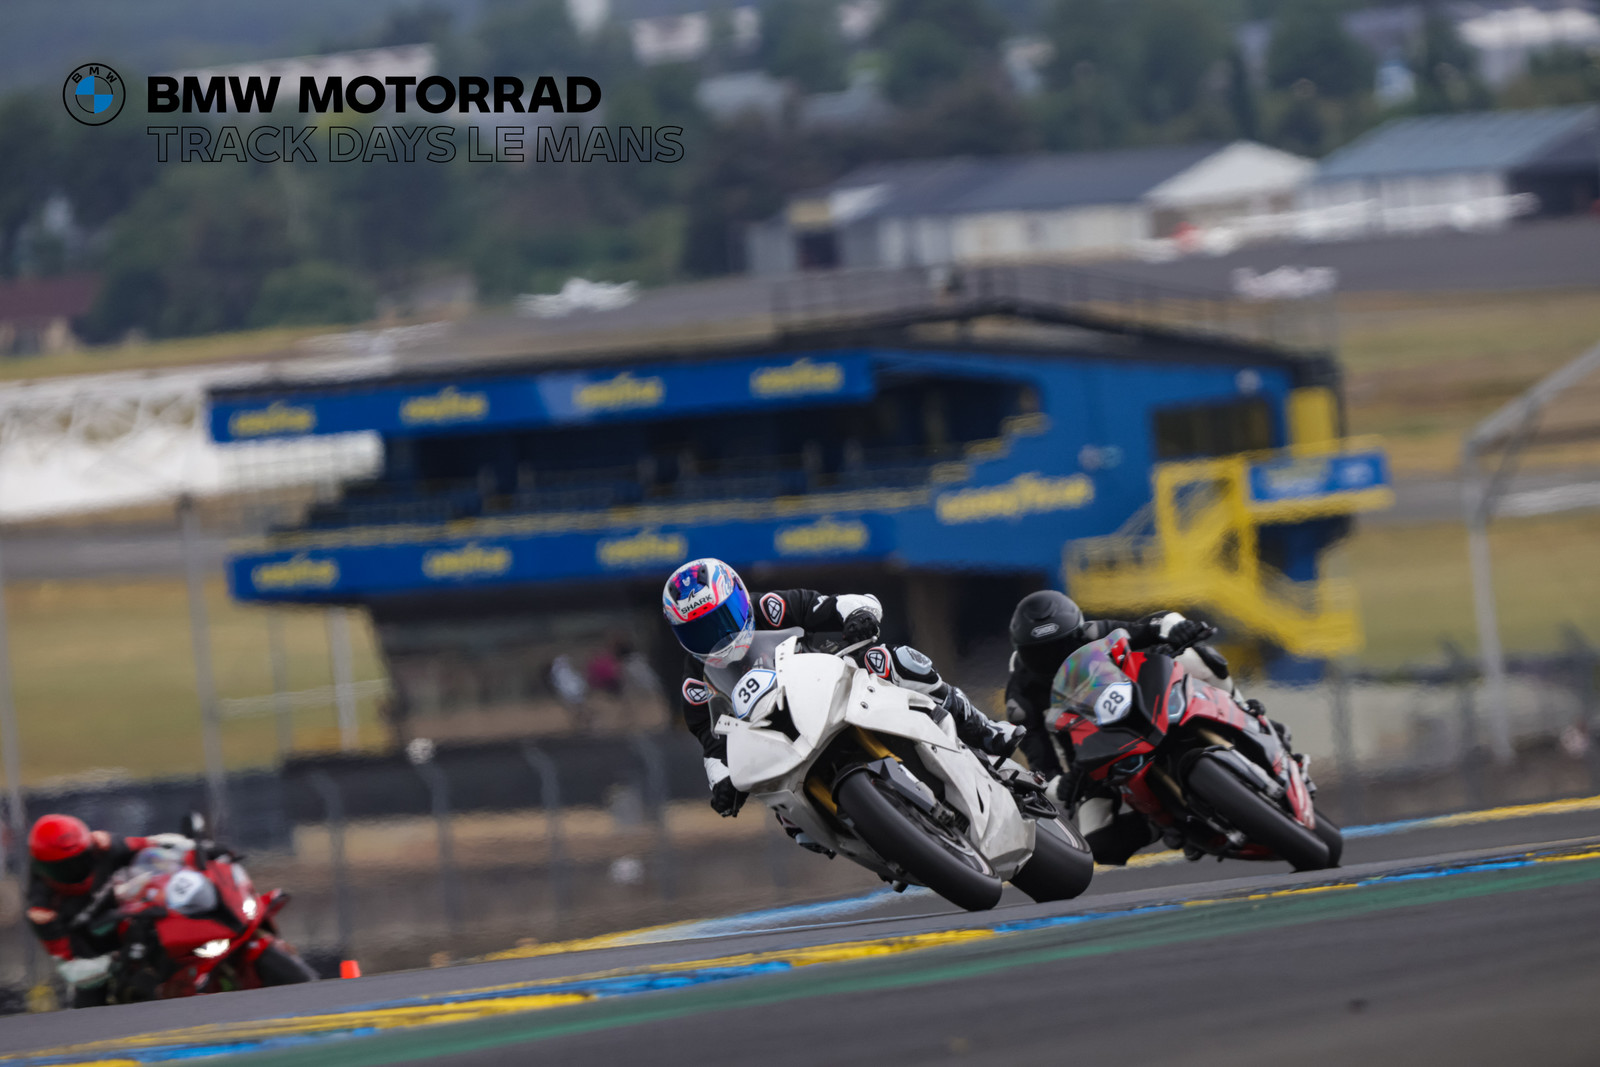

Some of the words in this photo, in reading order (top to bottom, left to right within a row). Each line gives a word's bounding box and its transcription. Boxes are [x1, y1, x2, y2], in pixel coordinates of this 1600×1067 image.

[680, 594, 713, 615] SHARK
[738, 677, 760, 704] 39
[1102, 690, 1125, 716] 28
